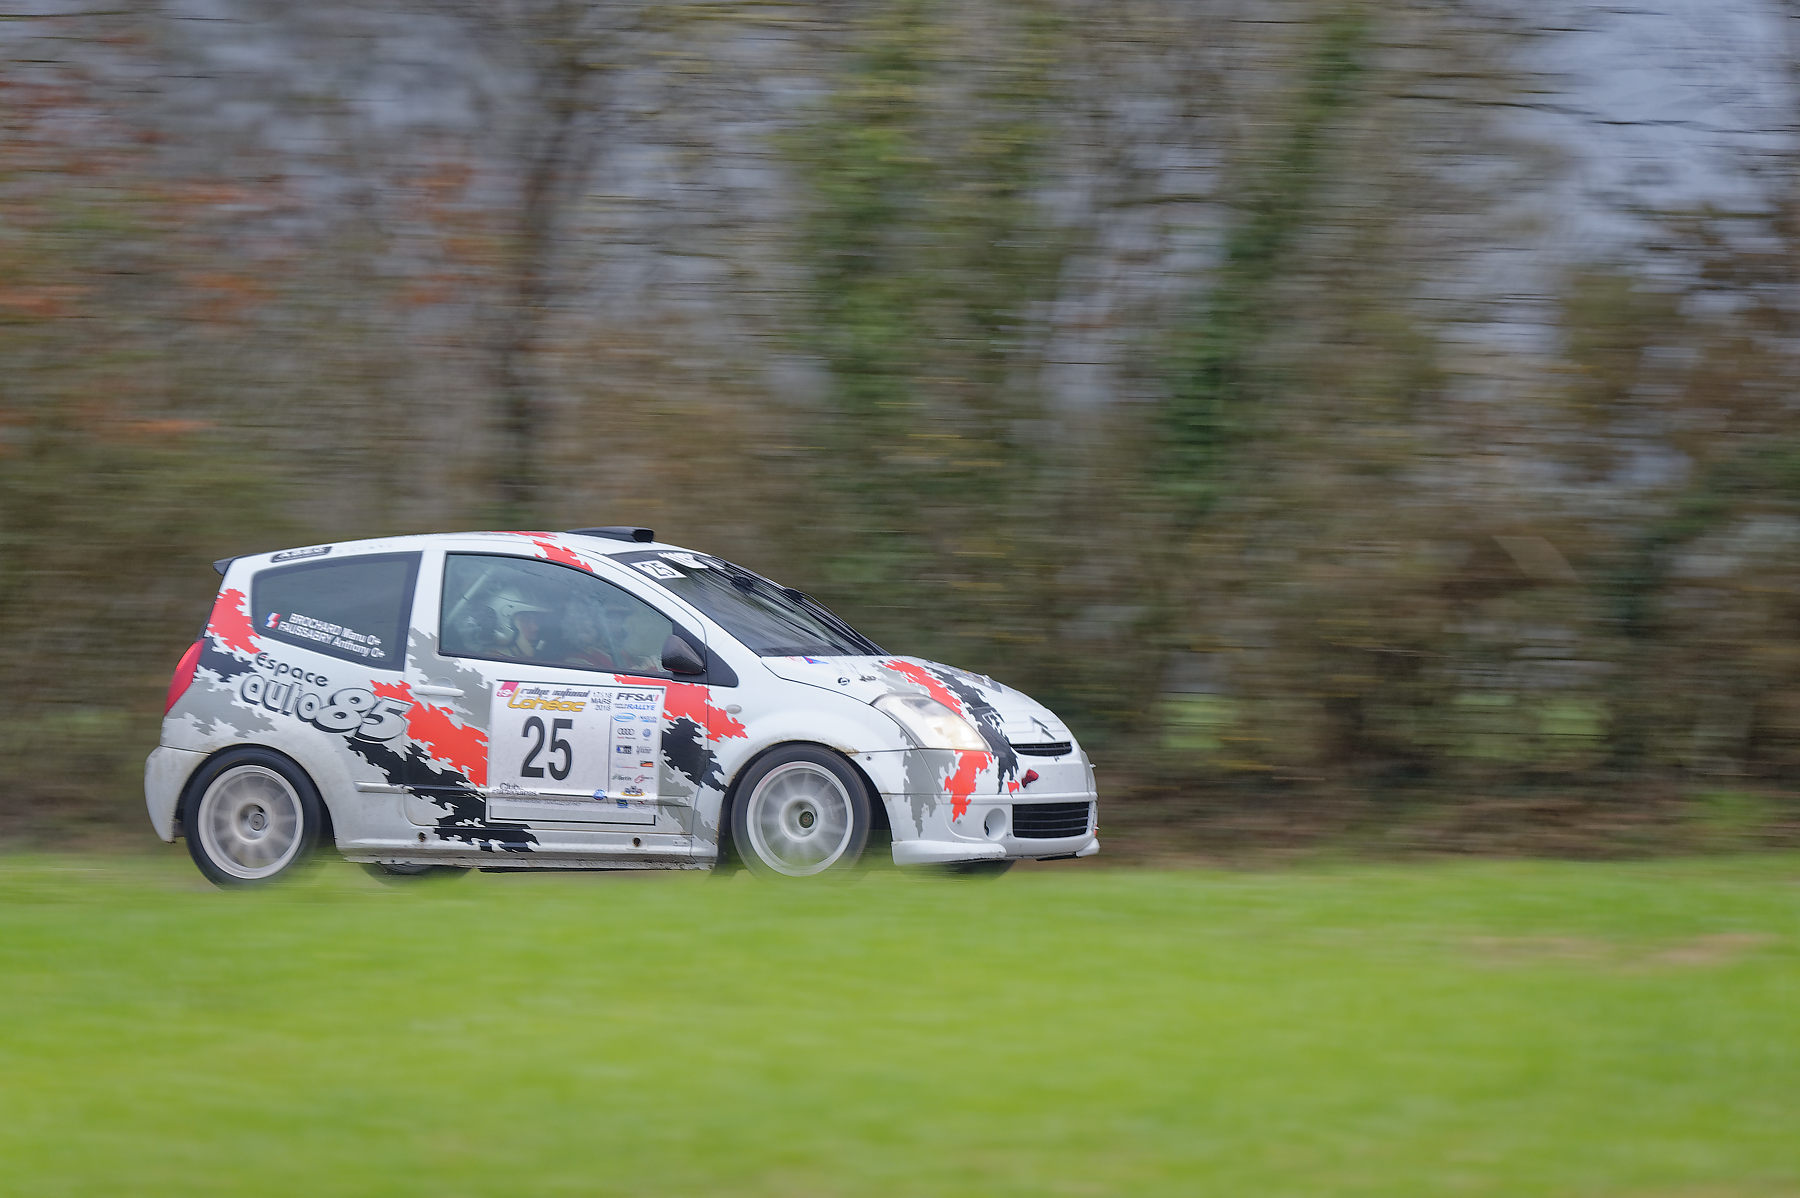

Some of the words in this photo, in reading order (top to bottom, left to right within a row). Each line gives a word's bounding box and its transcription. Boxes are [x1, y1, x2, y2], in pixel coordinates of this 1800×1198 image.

[640, 562, 676, 577] 25
[288, 612, 343, 636] BROCHARD
[331, 636, 371, 658] Anthony
[255, 652, 329, 687] Espace
[616, 692, 653, 702] FFSA
[520, 716, 573, 781] 25
